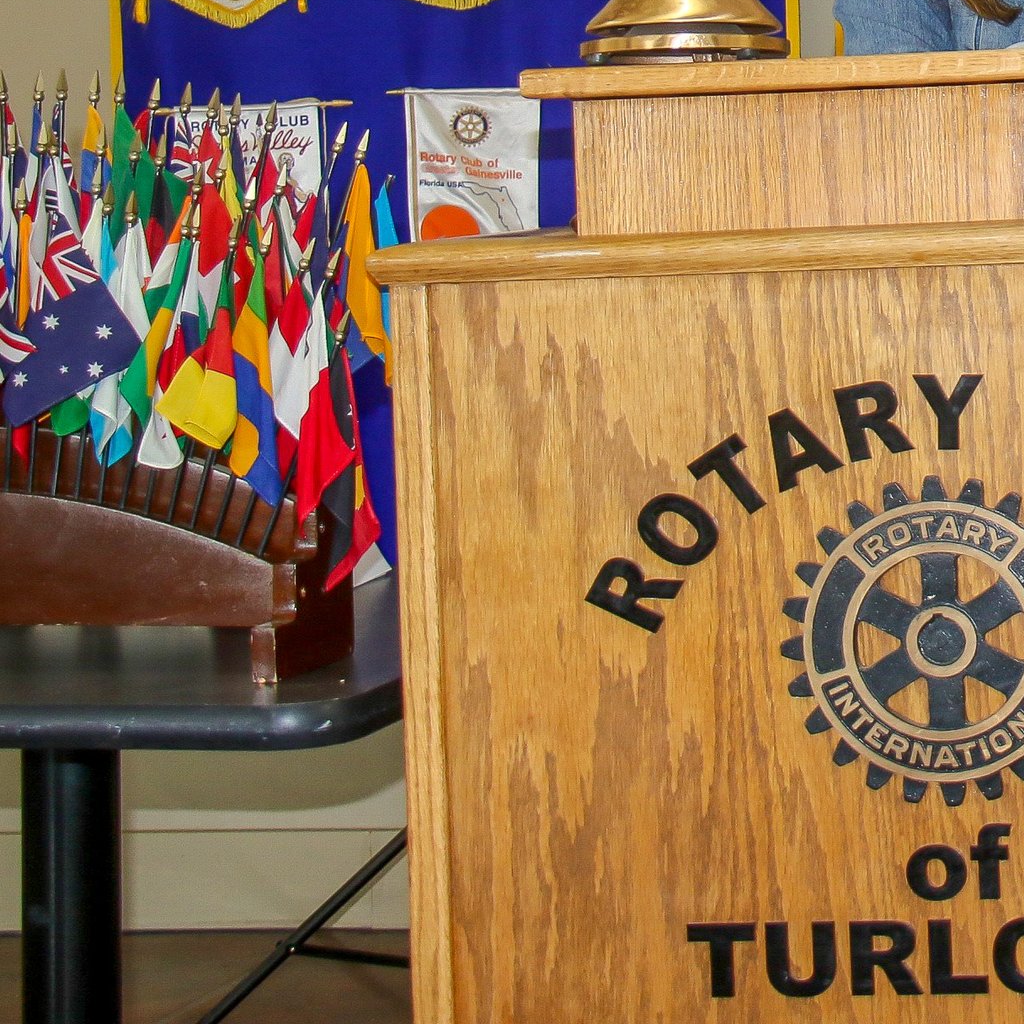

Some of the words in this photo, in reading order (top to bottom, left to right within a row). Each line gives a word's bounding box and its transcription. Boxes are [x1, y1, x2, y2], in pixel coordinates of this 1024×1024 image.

[275, 115, 309, 127] LUB
[420, 152, 457, 165] Rotary
[461, 156, 482, 166] Club
[487, 158, 499, 168] of
[466, 167, 523, 179] Gainesville
[420, 179, 444, 187] Florida
[583, 374, 984, 634] ROTARY
[861, 515, 1016, 564] ROTARY
[906, 823, 1013, 901] of
